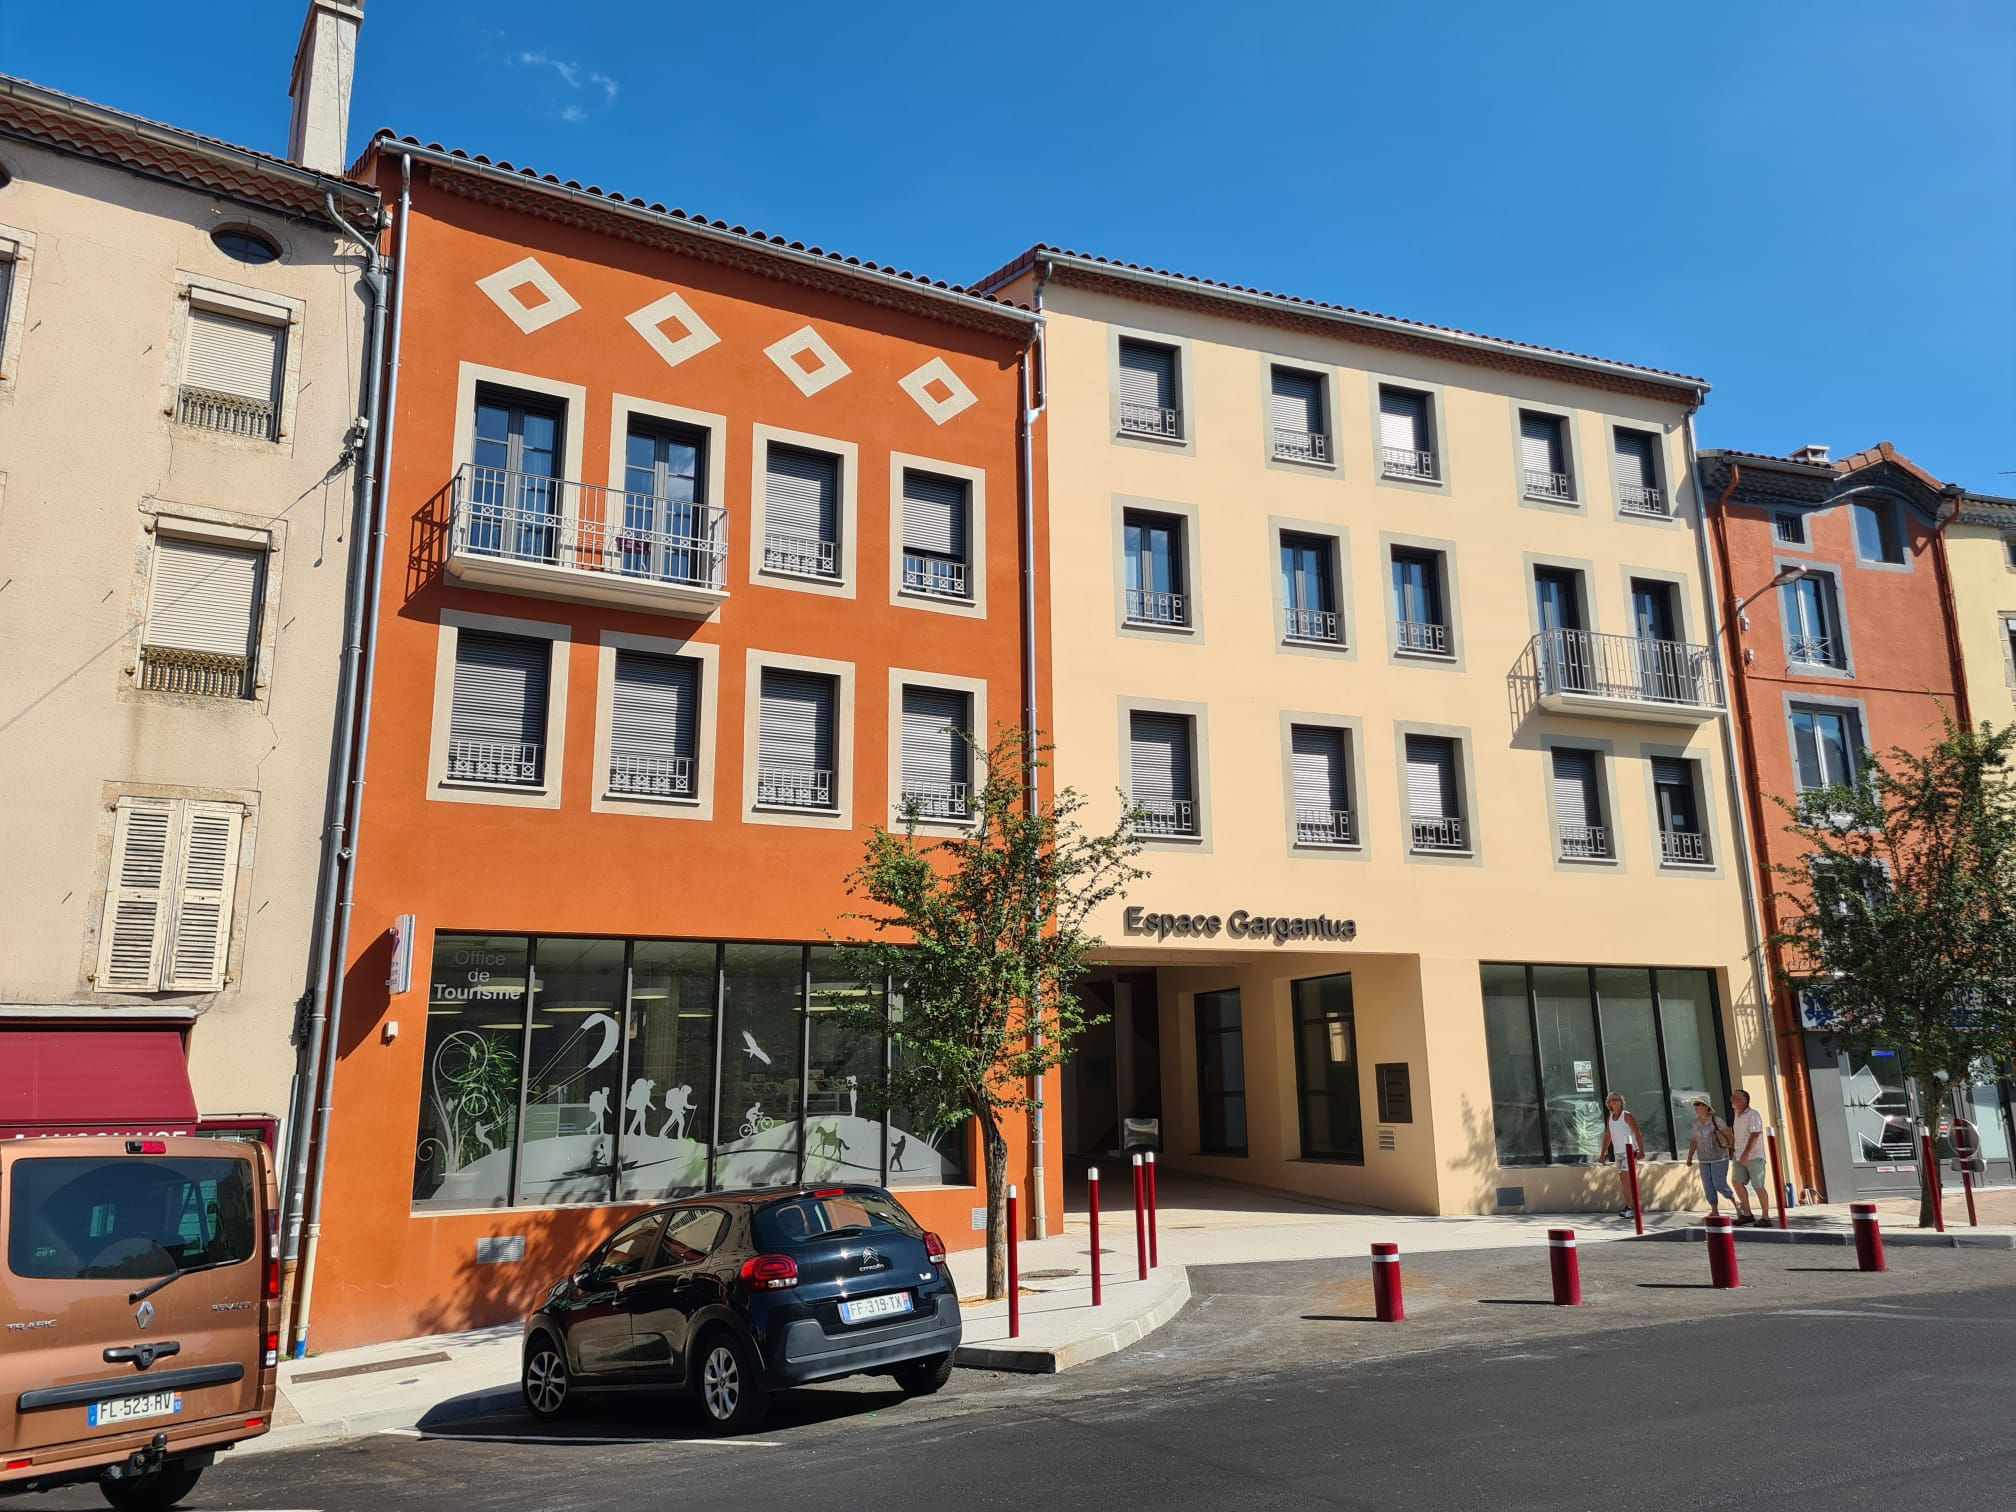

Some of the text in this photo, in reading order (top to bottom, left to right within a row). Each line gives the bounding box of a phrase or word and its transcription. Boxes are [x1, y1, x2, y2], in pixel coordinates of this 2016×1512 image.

[1124, 905, 1357, 943] Espace Gargantua
[455, 950, 506, 966] Office
[467, 968, 491, 982] de
[433, 984, 521, 1000] Tourisme
[849, 1295, 903, 1317] FF-319-TX
[100, 1392, 171, 1419] FL-523-RV
